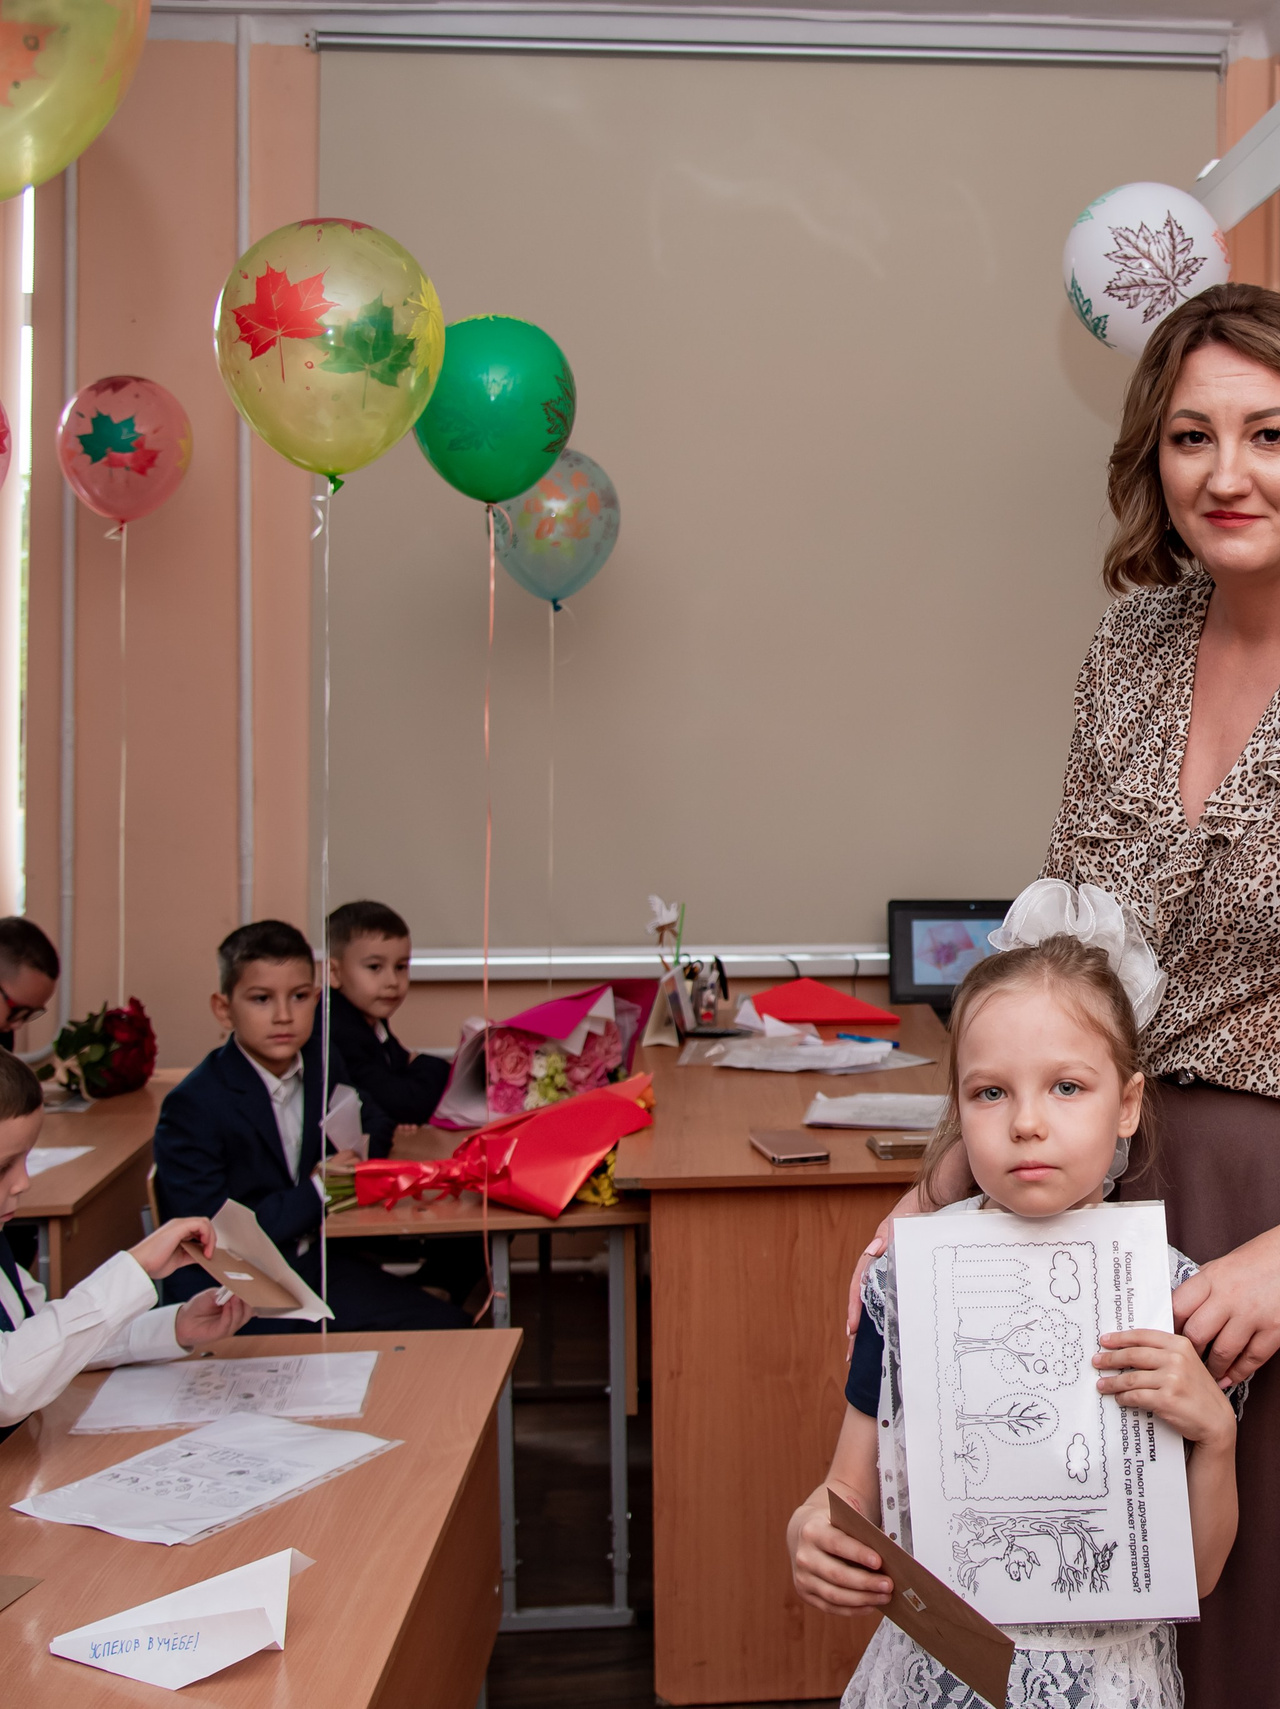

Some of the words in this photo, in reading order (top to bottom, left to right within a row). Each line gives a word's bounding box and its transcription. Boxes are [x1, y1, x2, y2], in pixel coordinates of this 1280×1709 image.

[1112, 1240, 1120, 1254] ся:
[1113, 1256, 1122, 1292] обведи
[1124, 1251, 1133, 1285] Кошка,
[1113, 1294, 1123, 1331] предме
[1126, 1287, 1135, 1323] Мышка
[1132, 1419, 1142, 1457] прятки.
[1146, 1421, 1157, 1462] прятки
[1123, 1458, 1132, 1476] Кто
[1135, 1459, 1145, 1498] Помоги
[1124, 1478, 1133, 1496] где
[1126, 1498, 1135, 1530] может
[1137, 1499, 1148, 1542] друзьям
[1128, 1532, 1142, 1593] спрятаться?
[1141, 1544, 1151, 1593] спрятать-
[88, 1638, 141, 1660] УСПЕХОВ
